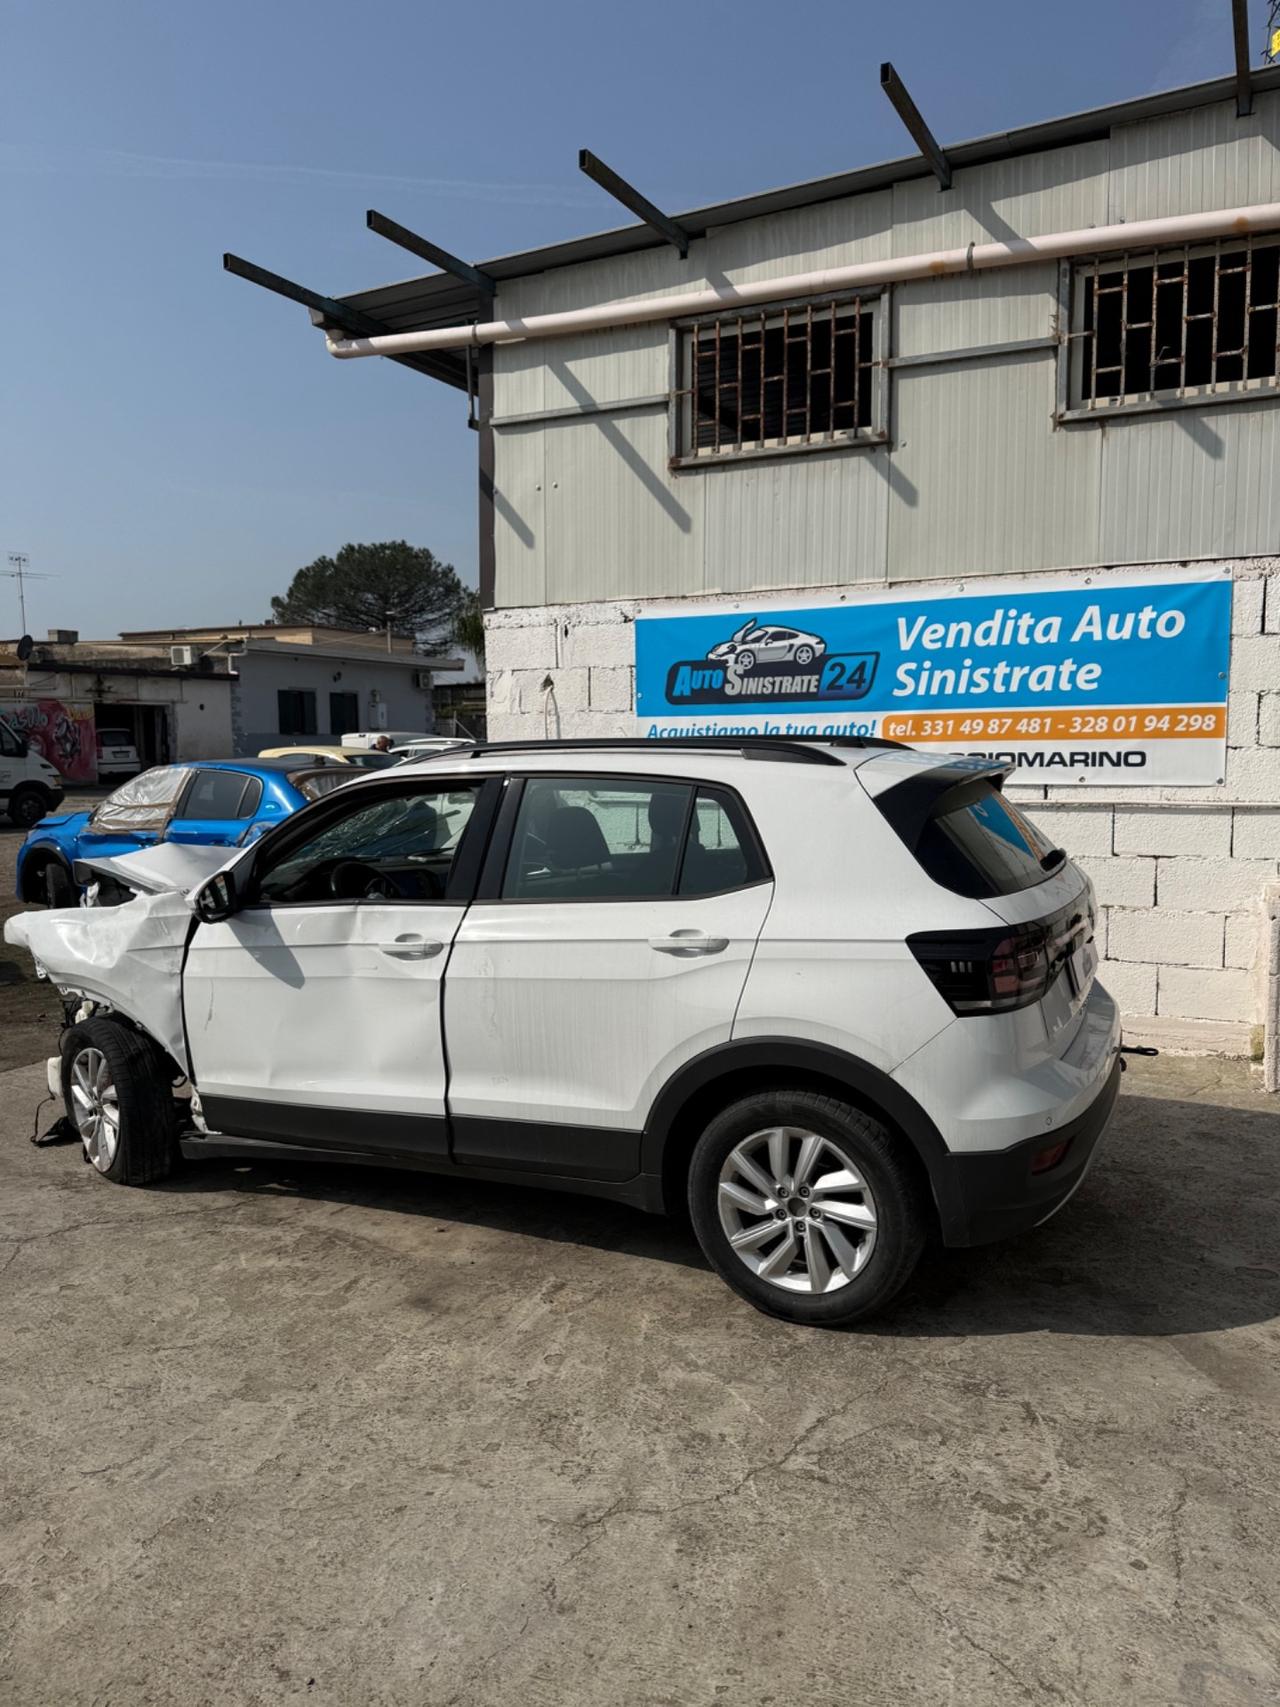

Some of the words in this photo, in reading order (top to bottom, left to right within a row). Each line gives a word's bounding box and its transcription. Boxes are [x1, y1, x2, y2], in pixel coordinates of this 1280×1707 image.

[897, 609, 1062, 651] Vendita
[1070, 605, 1186, 642] Auto
[673, 665, 724, 696] AUTO
[827, 660, 867, 691] 24
[892, 658, 1102, 697] Sinistrate
[648, 723, 759, 738] Acquistiamo
[763, 721, 781, 736] la
[785, 723, 818, 736] tua
[822, 719, 877, 737] auto!
[889, 719, 916, 736] tel.
[921, 720, 954, 736] 331
[960, 719, 984, 735] 49
[987, 718, 1013, 735] 87
[1016, 717, 1053, 734] 481
[1069, 716, 1109, 733] 328
[1112, 715, 1138, 732] 01
[1144, 715, 1171, 732] 94
[1174, 714, 1217, 732] 298
